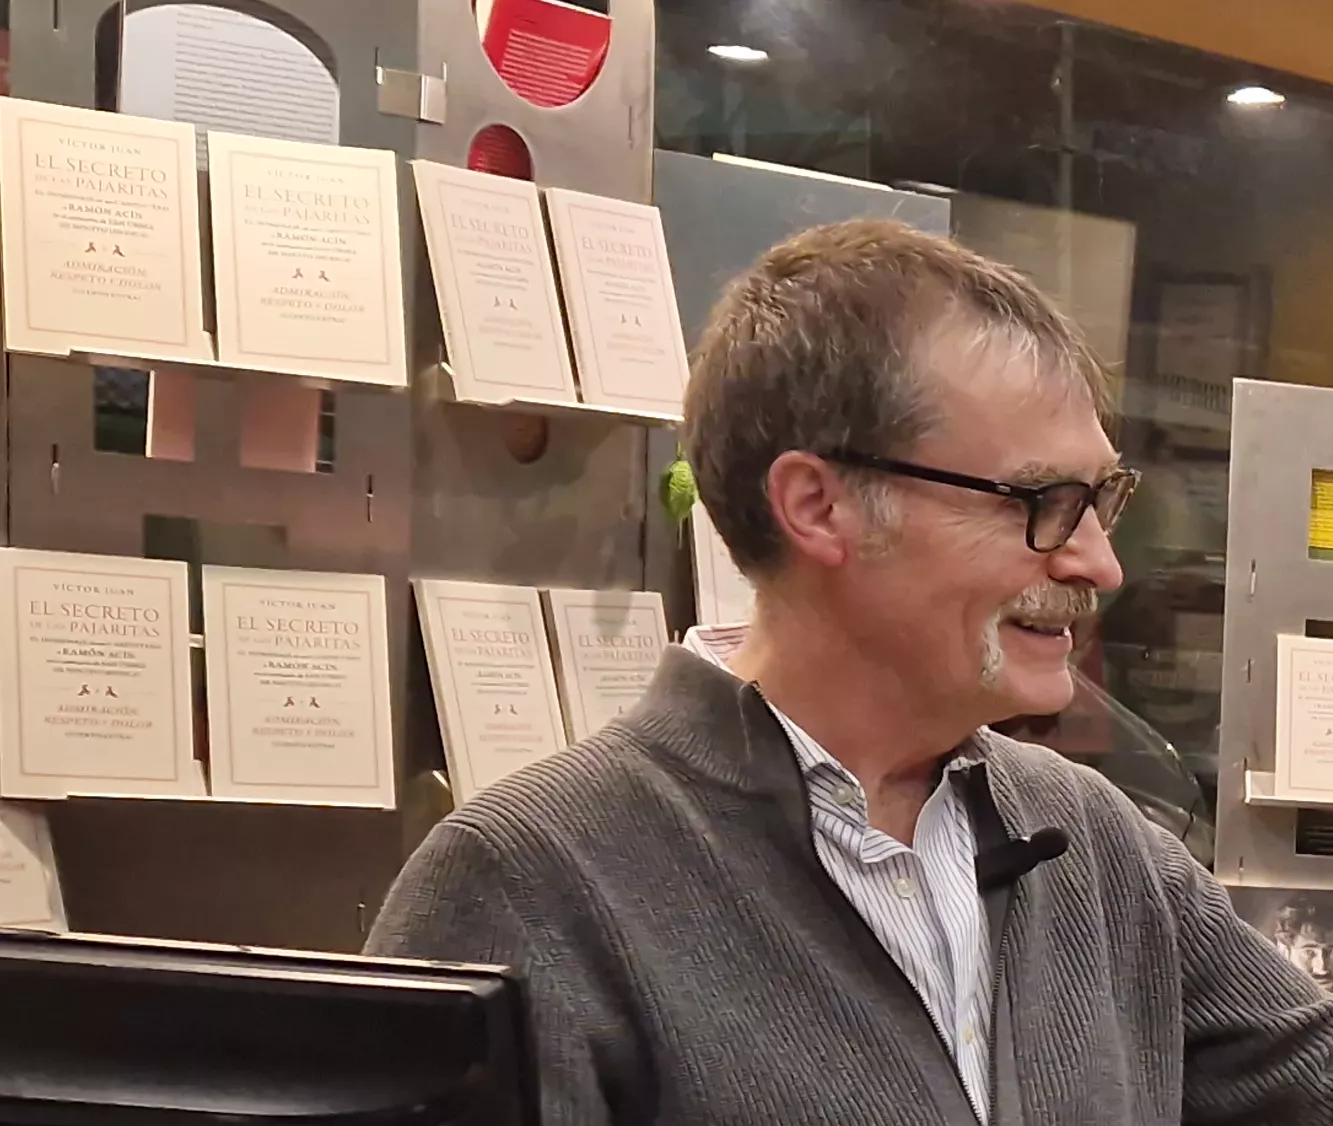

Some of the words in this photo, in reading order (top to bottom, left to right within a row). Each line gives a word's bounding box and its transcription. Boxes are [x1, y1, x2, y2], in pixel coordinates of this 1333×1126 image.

[34, 153, 60, 170] EL
[66, 157, 167, 184] SECRETO
[76, 176, 168, 199] PAJARITAS
[244, 184, 268, 200] EL
[273, 188, 370, 210] SECRETO
[29, 600, 55, 616] EL
[60, 602, 160, 623] SECRETO
[70, 621, 161, 638] PAJARITAS
[237, 615, 261, 631] EL
[266, 618, 360, 635] SECRETO
[275, 636, 361, 650] PAJARITAS
